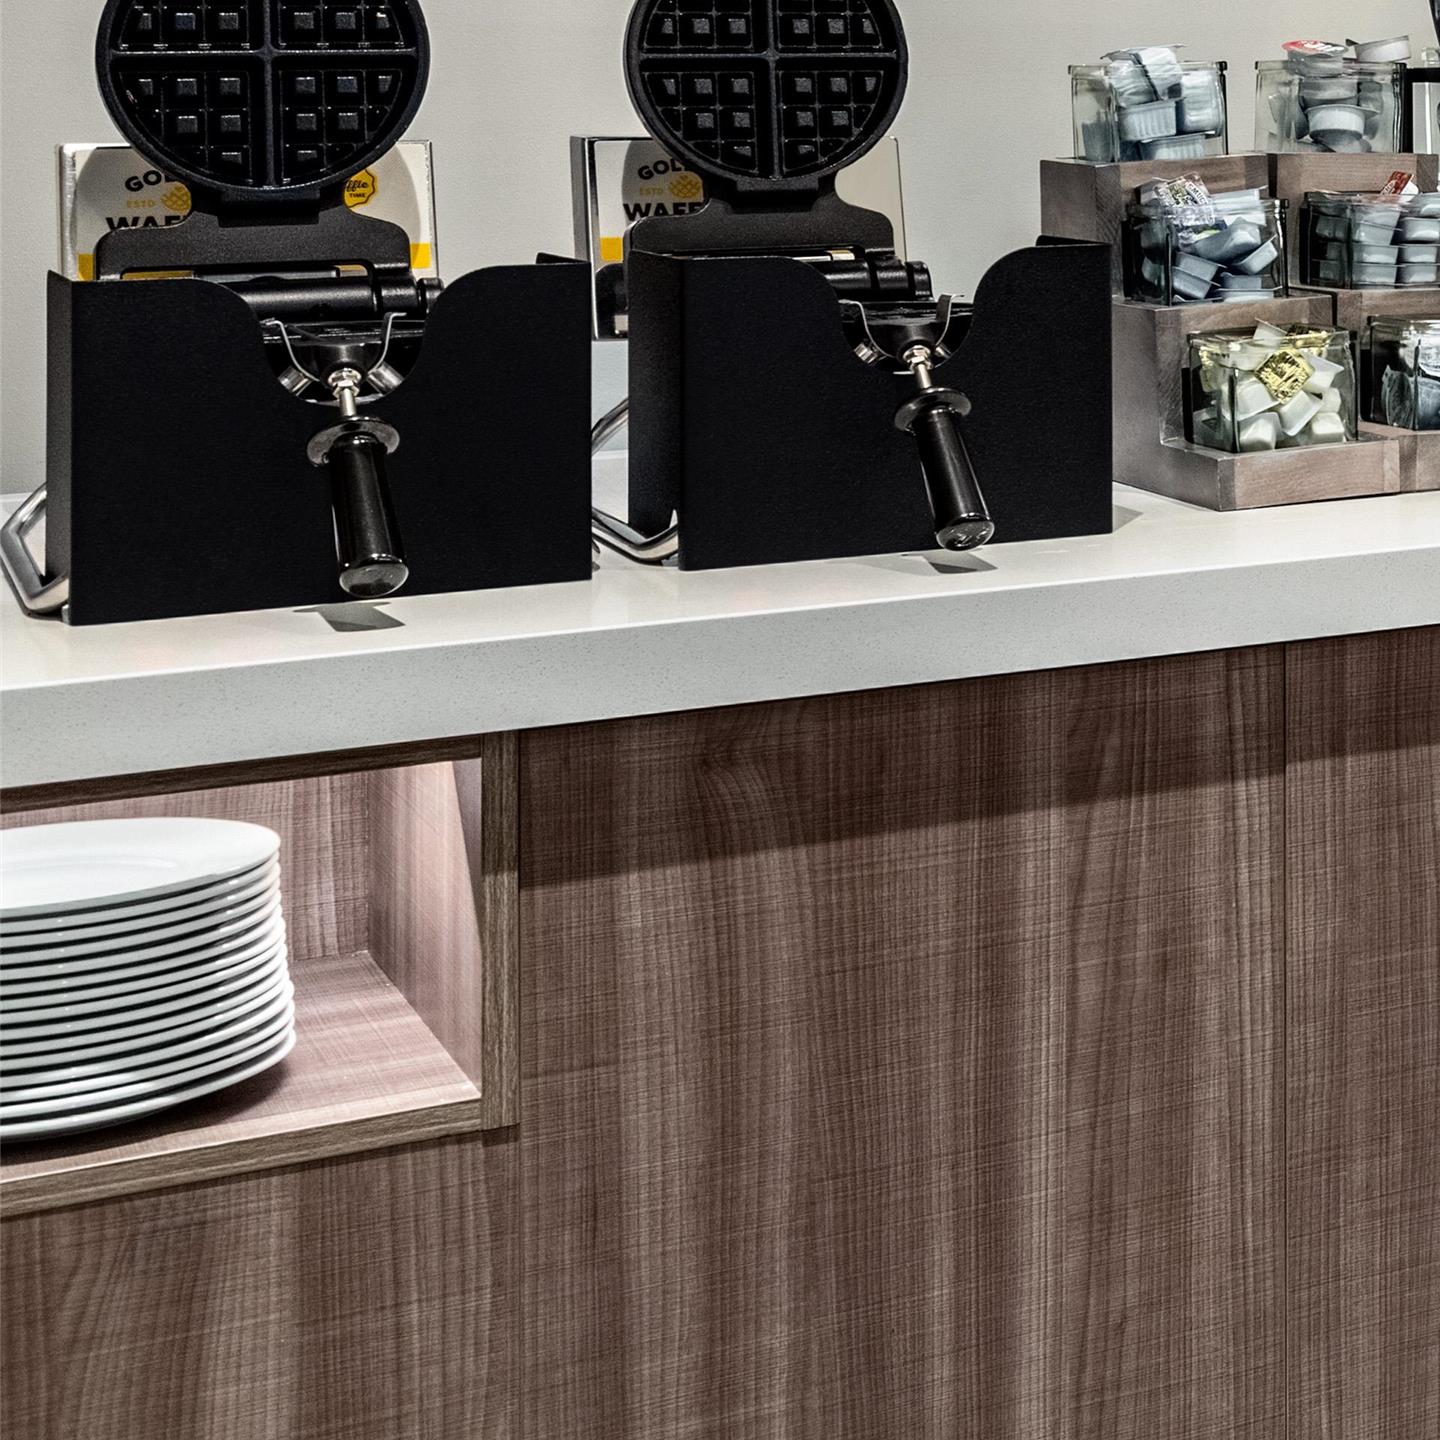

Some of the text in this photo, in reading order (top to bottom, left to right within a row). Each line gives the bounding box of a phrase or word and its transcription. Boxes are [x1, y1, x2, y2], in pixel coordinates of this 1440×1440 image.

[638, 159, 684, 180] GOL
[346, 180, 368, 192] ffle
[623, 203, 703, 222] WAFF
[106, 216, 185, 231] WAF
